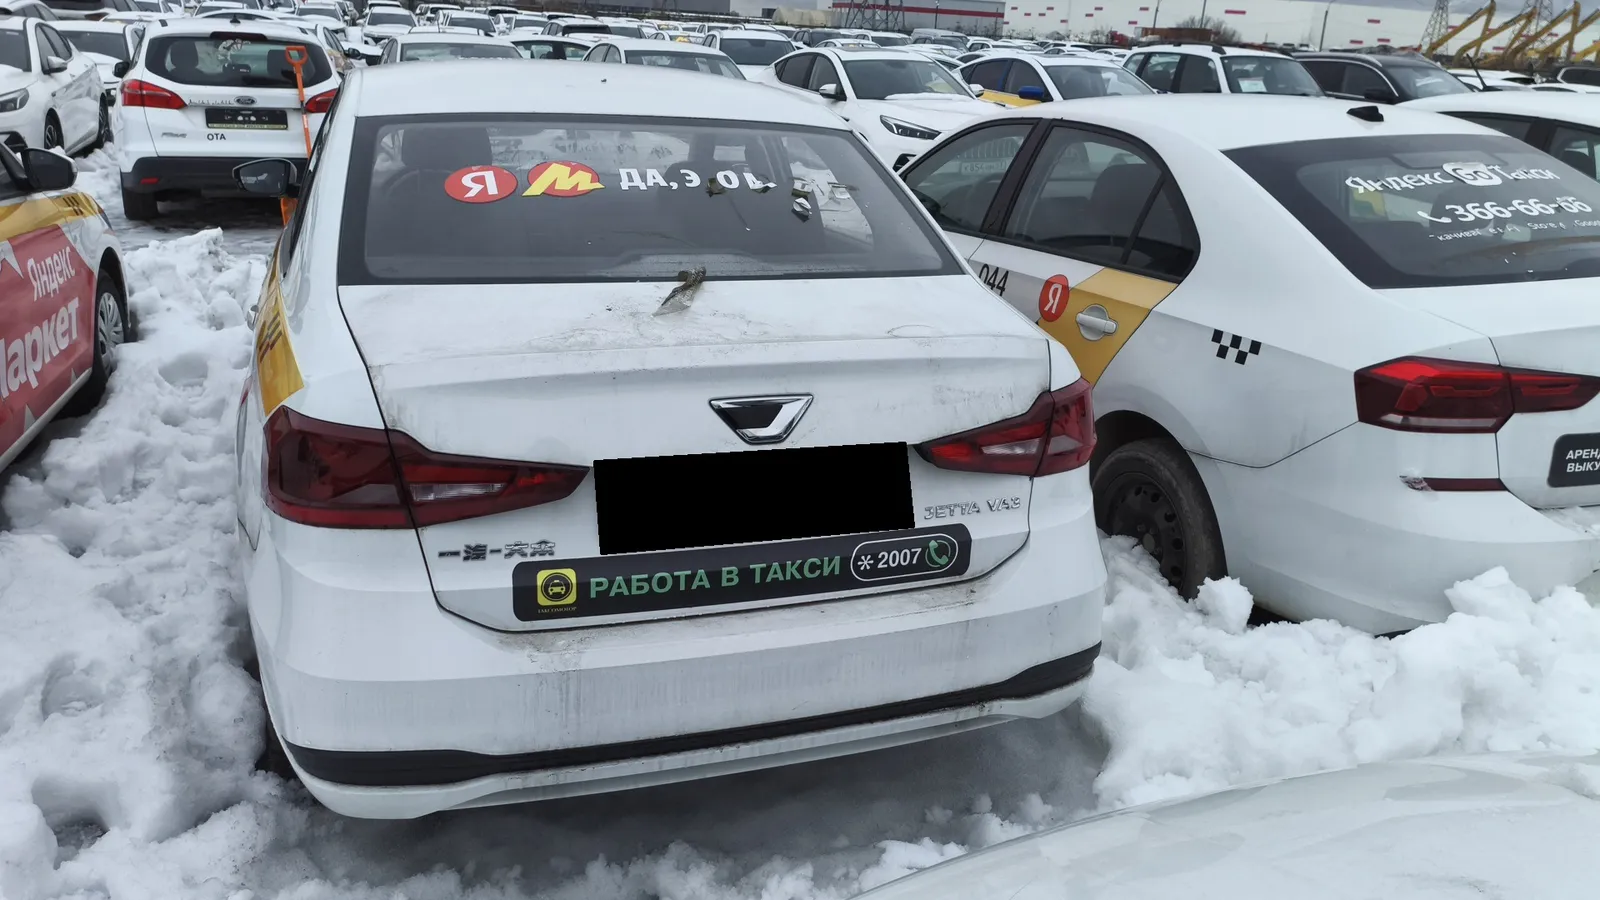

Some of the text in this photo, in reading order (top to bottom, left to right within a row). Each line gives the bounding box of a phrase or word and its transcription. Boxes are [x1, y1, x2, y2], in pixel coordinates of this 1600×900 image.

[461, 170, 499, 199] Я
[1345, 172, 1454, 194] Яндекс
[1445, 196, 1593, 222] 366-66-66
[27, 246, 76, 302] Яндекс
[1043, 283, 1063, 314] Я
[924, 501, 980, 519] JETTA
[590, 569, 711, 599] РАБОТА
[721, 566, 740, 588] В
[750, 556, 842, 584] ТАКСИ
